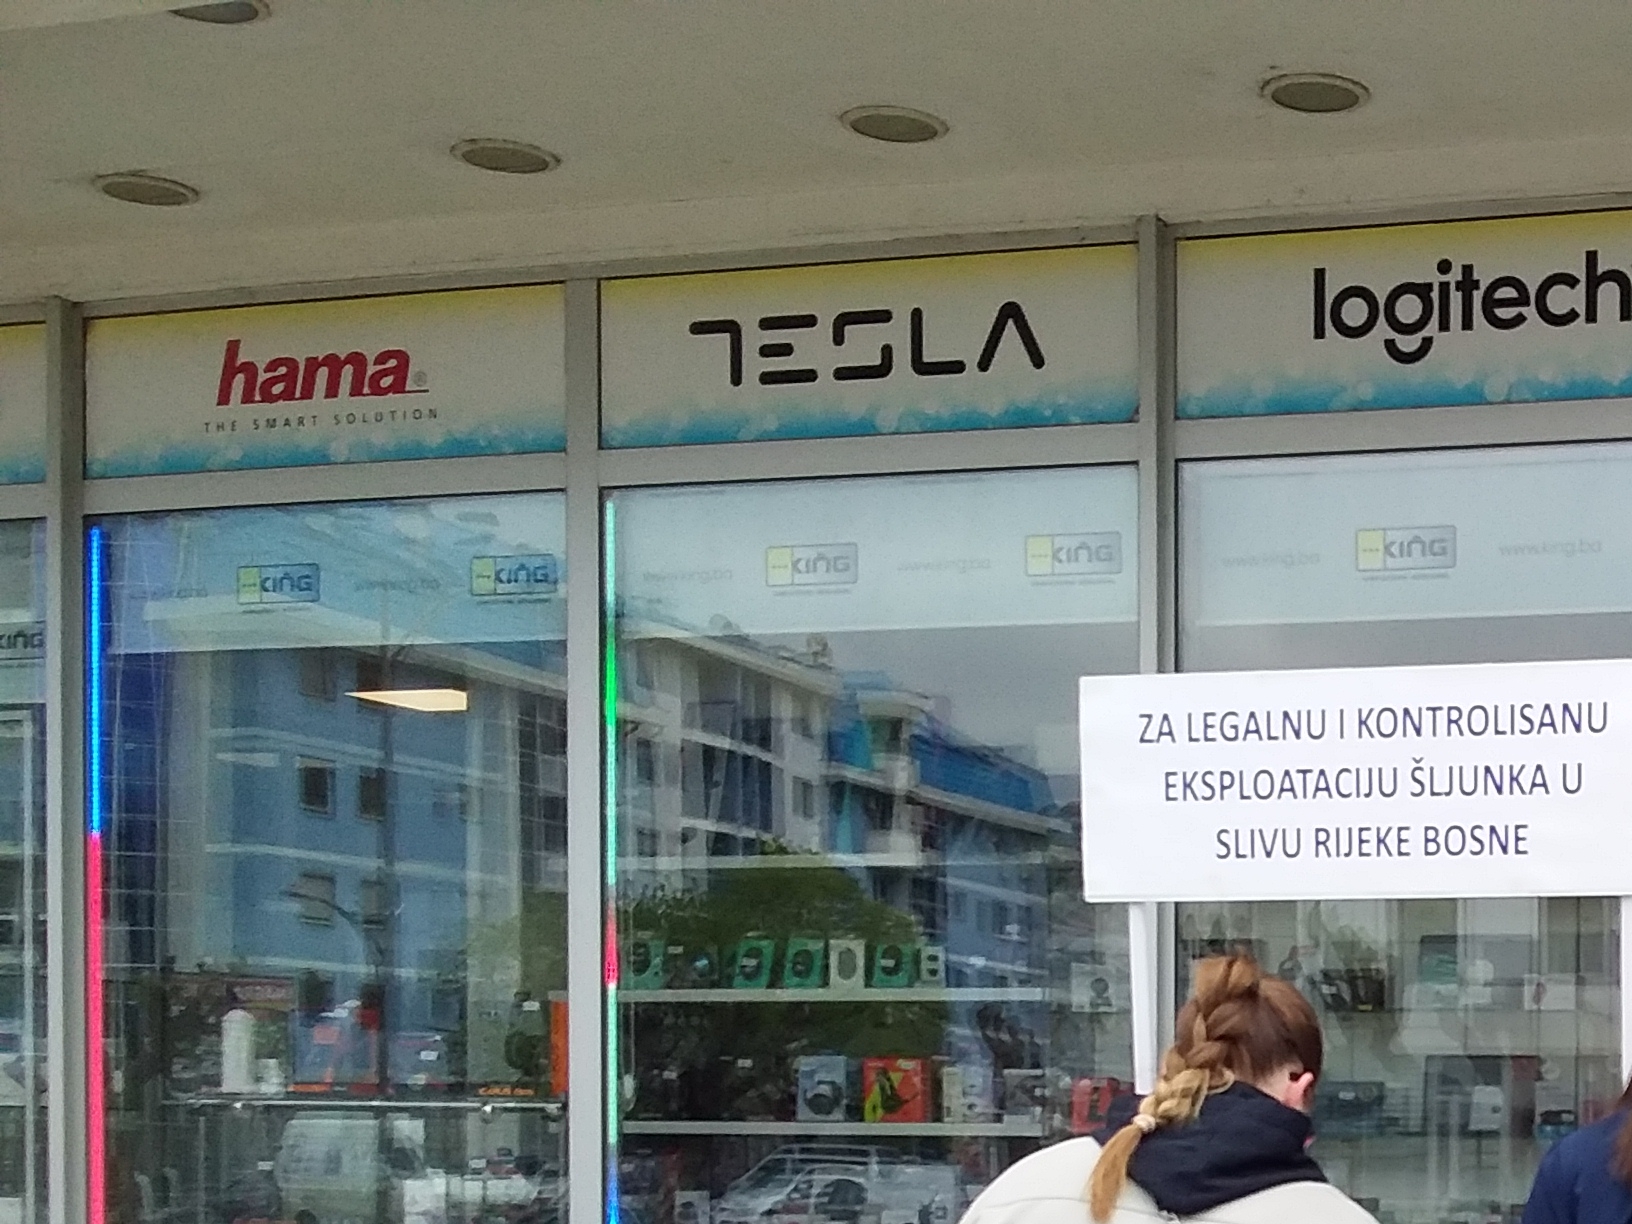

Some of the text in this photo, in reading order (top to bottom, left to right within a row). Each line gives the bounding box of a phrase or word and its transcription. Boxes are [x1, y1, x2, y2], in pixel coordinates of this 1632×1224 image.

[1313, 250, 1632, 364] logitech
[689, 301, 1045, 387] TESLA
[216, 339, 410, 406] hama
[204, 408, 438, 433] THE SMART SOLUTION
[792, 553, 850, 574] KING
[1053, 543, 1114, 565] KING
[1383, 537, 1448, 559] KING
[1138, 702, 1608, 744] ZA LEGALNU I KONTROLISANU
[1165, 757, 1583, 802] EKSPLOATACIJU ŠLJUNKA U
[1216, 824, 1530, 860] SLIVU RIJEKE BOSNE
